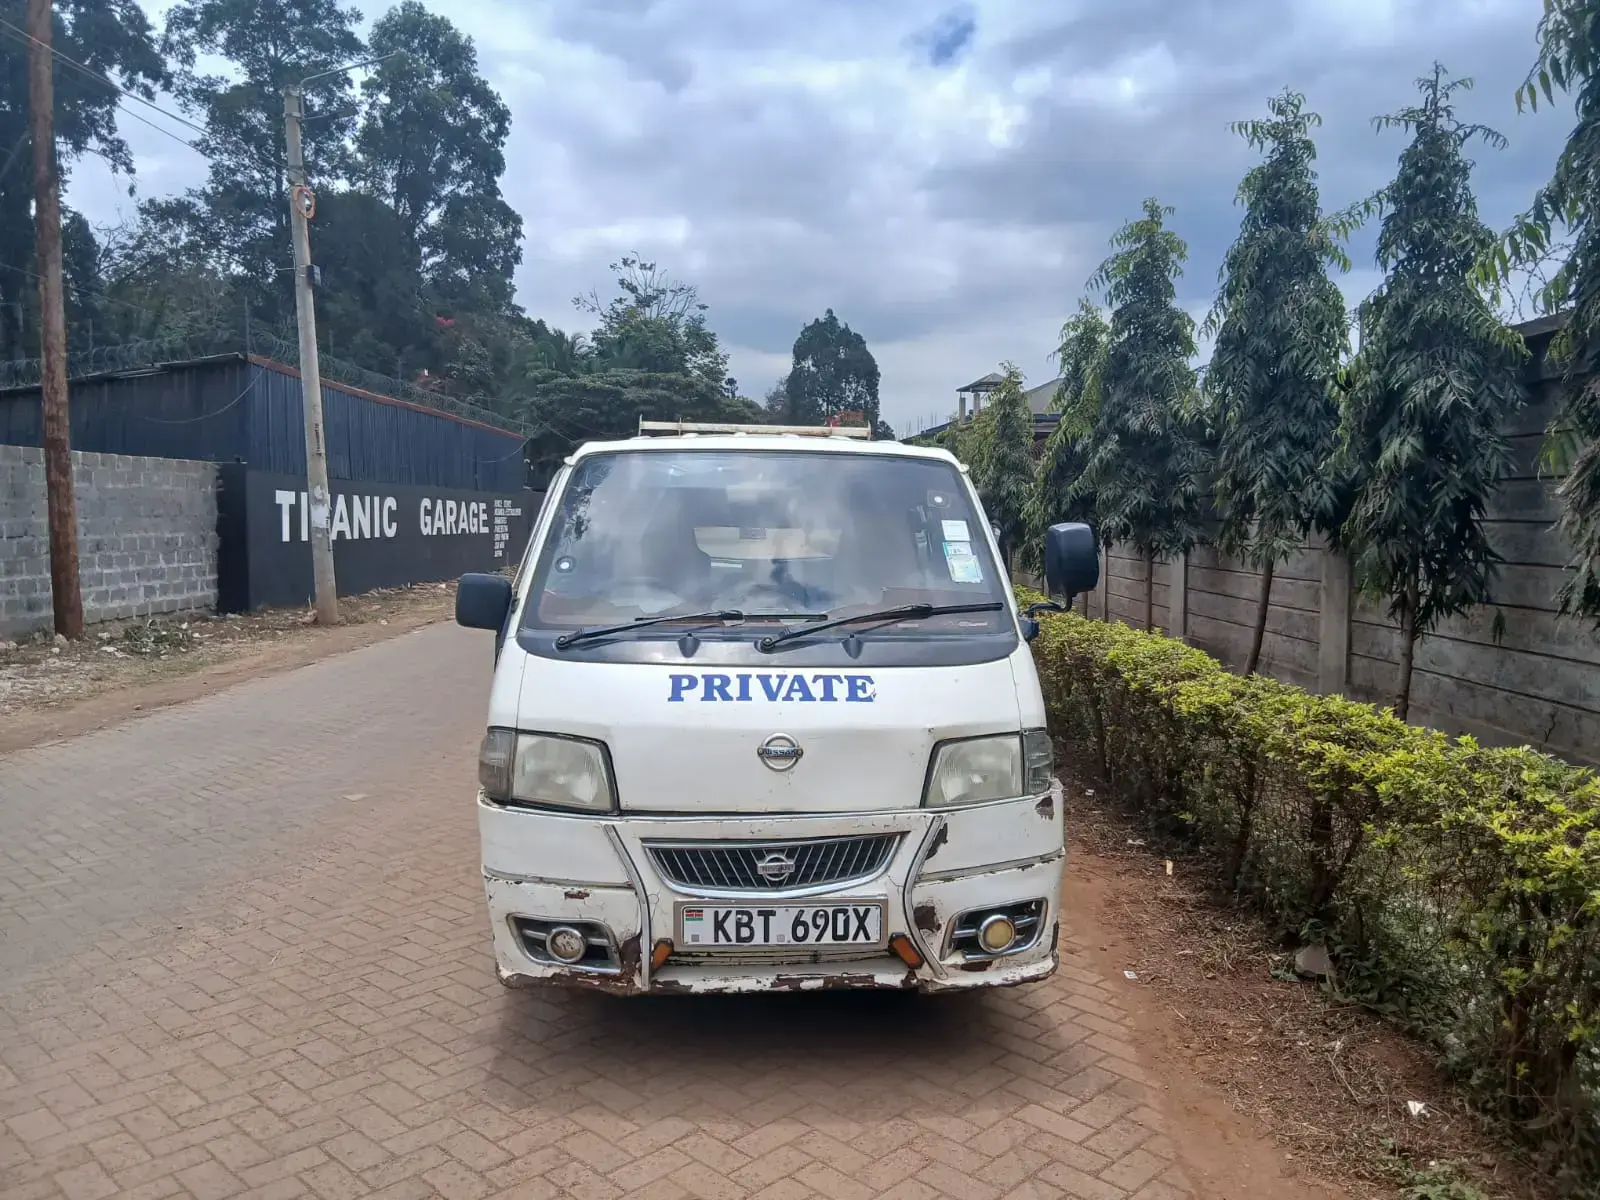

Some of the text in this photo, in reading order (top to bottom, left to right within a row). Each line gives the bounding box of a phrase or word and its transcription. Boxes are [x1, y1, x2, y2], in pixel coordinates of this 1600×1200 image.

[275, 490, 398, 542] TIANIC
[420, 497, 489, 536] GARAGE
[667, 673, 876, 703] PRIVATE
[713, 909, 777, 943] KBT
[791, 907, 871, 943] 690X
